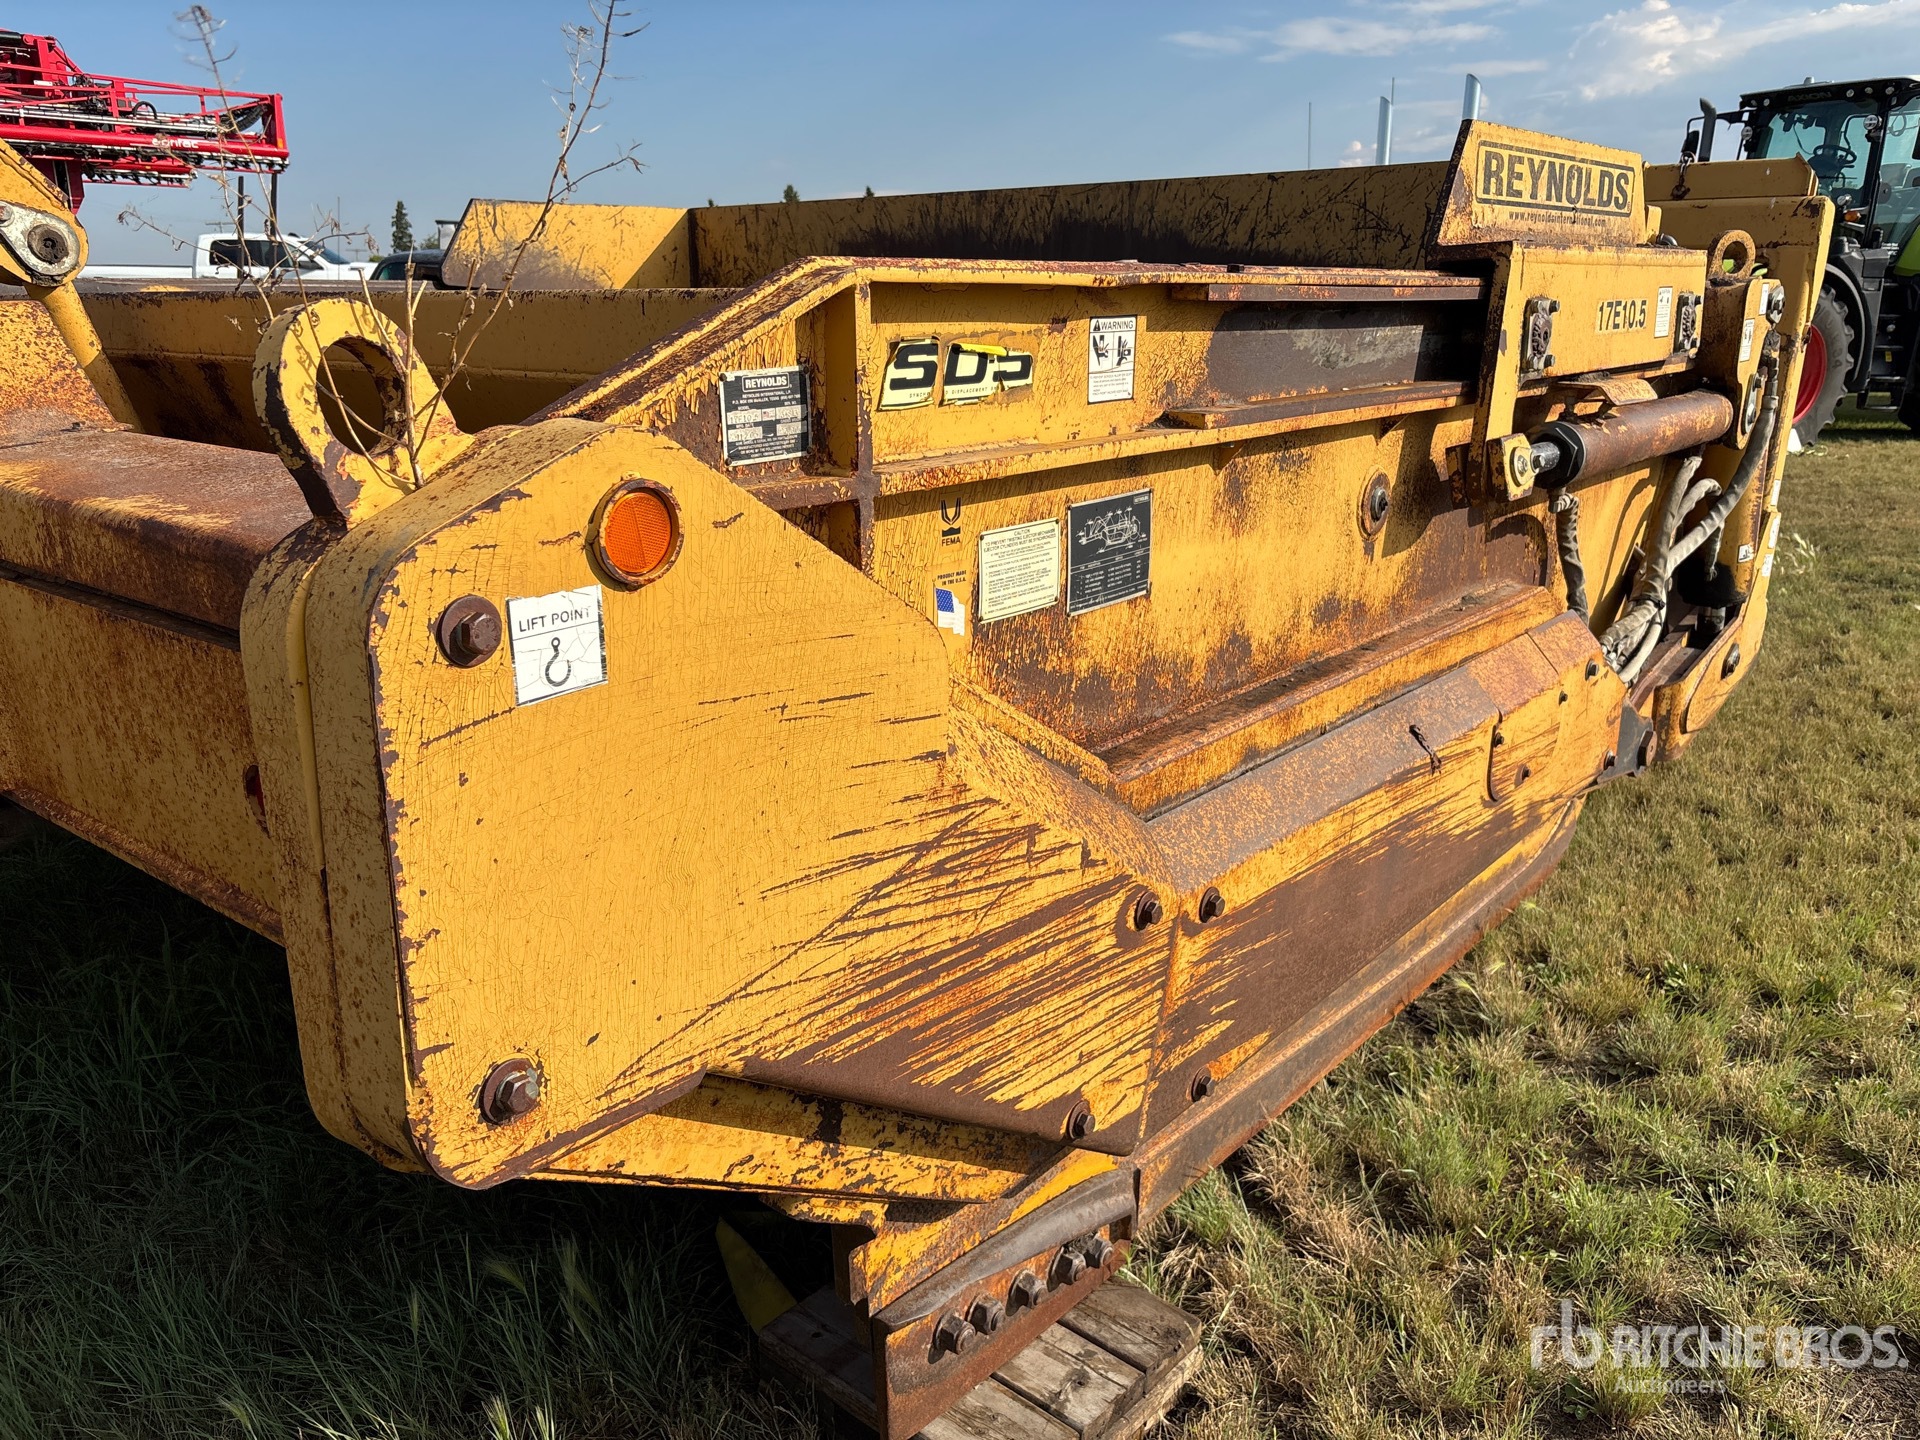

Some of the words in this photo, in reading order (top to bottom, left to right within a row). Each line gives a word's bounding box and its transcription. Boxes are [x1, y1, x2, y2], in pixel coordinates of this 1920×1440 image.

[1482, 149, 1630, 211] REYNOLDS
[1598, 299, 1647, 332] 17E10.5
[1101, 320, 1134, 331] WARNING
[745, 375, 787, 389] REYNOLDS
[942, 537, 961, 548] FEMA
[937, 572, 955, 580] PROUDLY
[955, 569, 967, 577] MADE
[518, 615, 547, 633] LIFT
